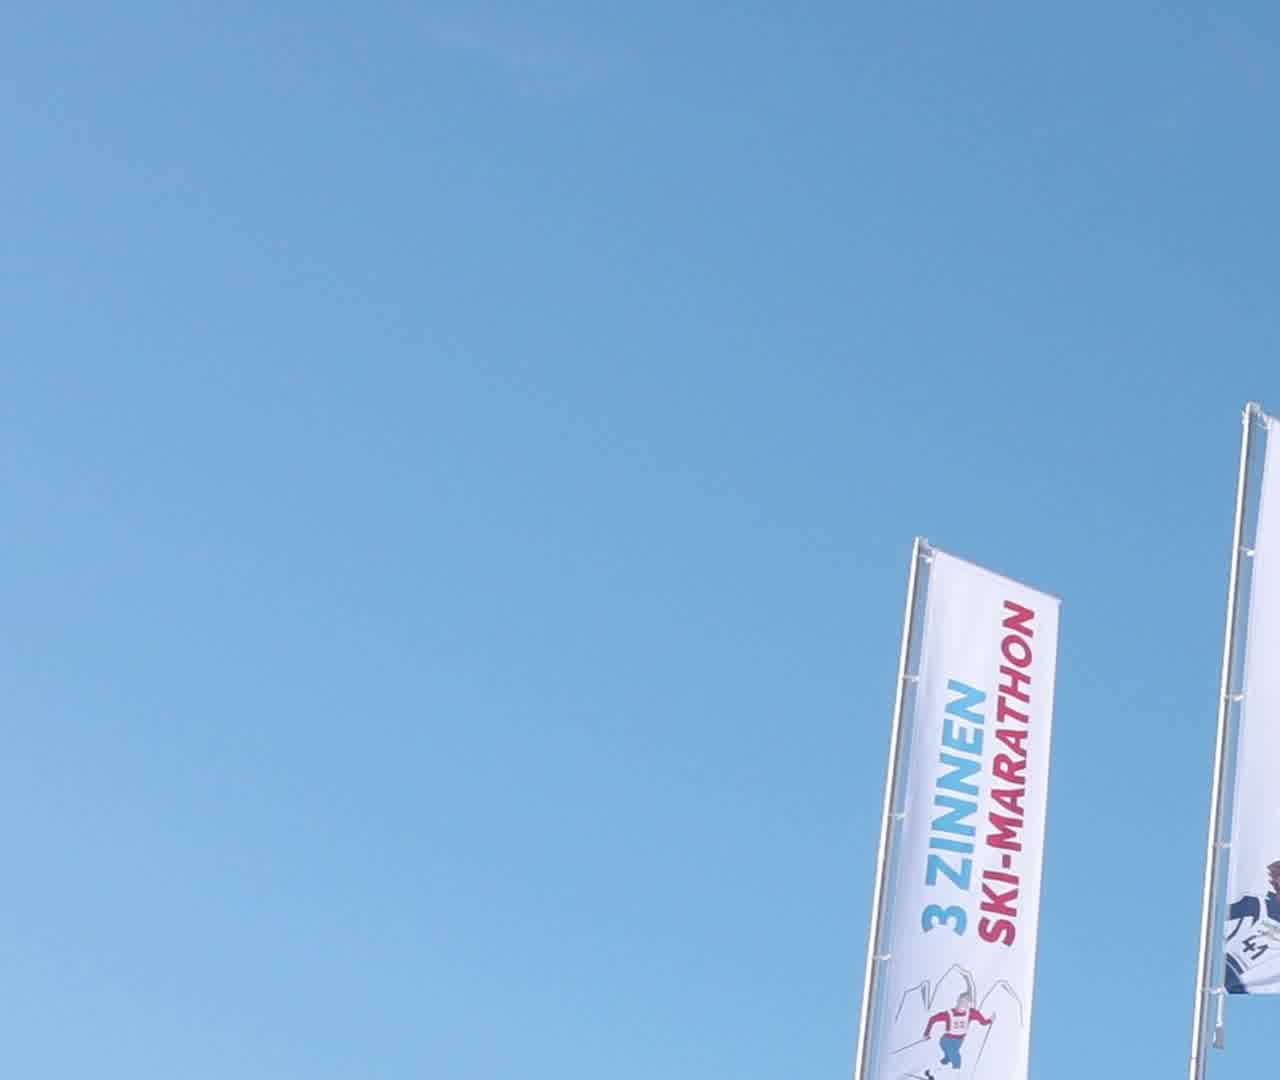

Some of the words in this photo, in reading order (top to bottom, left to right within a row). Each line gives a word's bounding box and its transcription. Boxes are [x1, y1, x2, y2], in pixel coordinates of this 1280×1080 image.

[925, 679, 988, 892] ZINNEN
[978, 600, 1036, 947] SKI-MARATHON
[921, 904, 967, 936] 3
